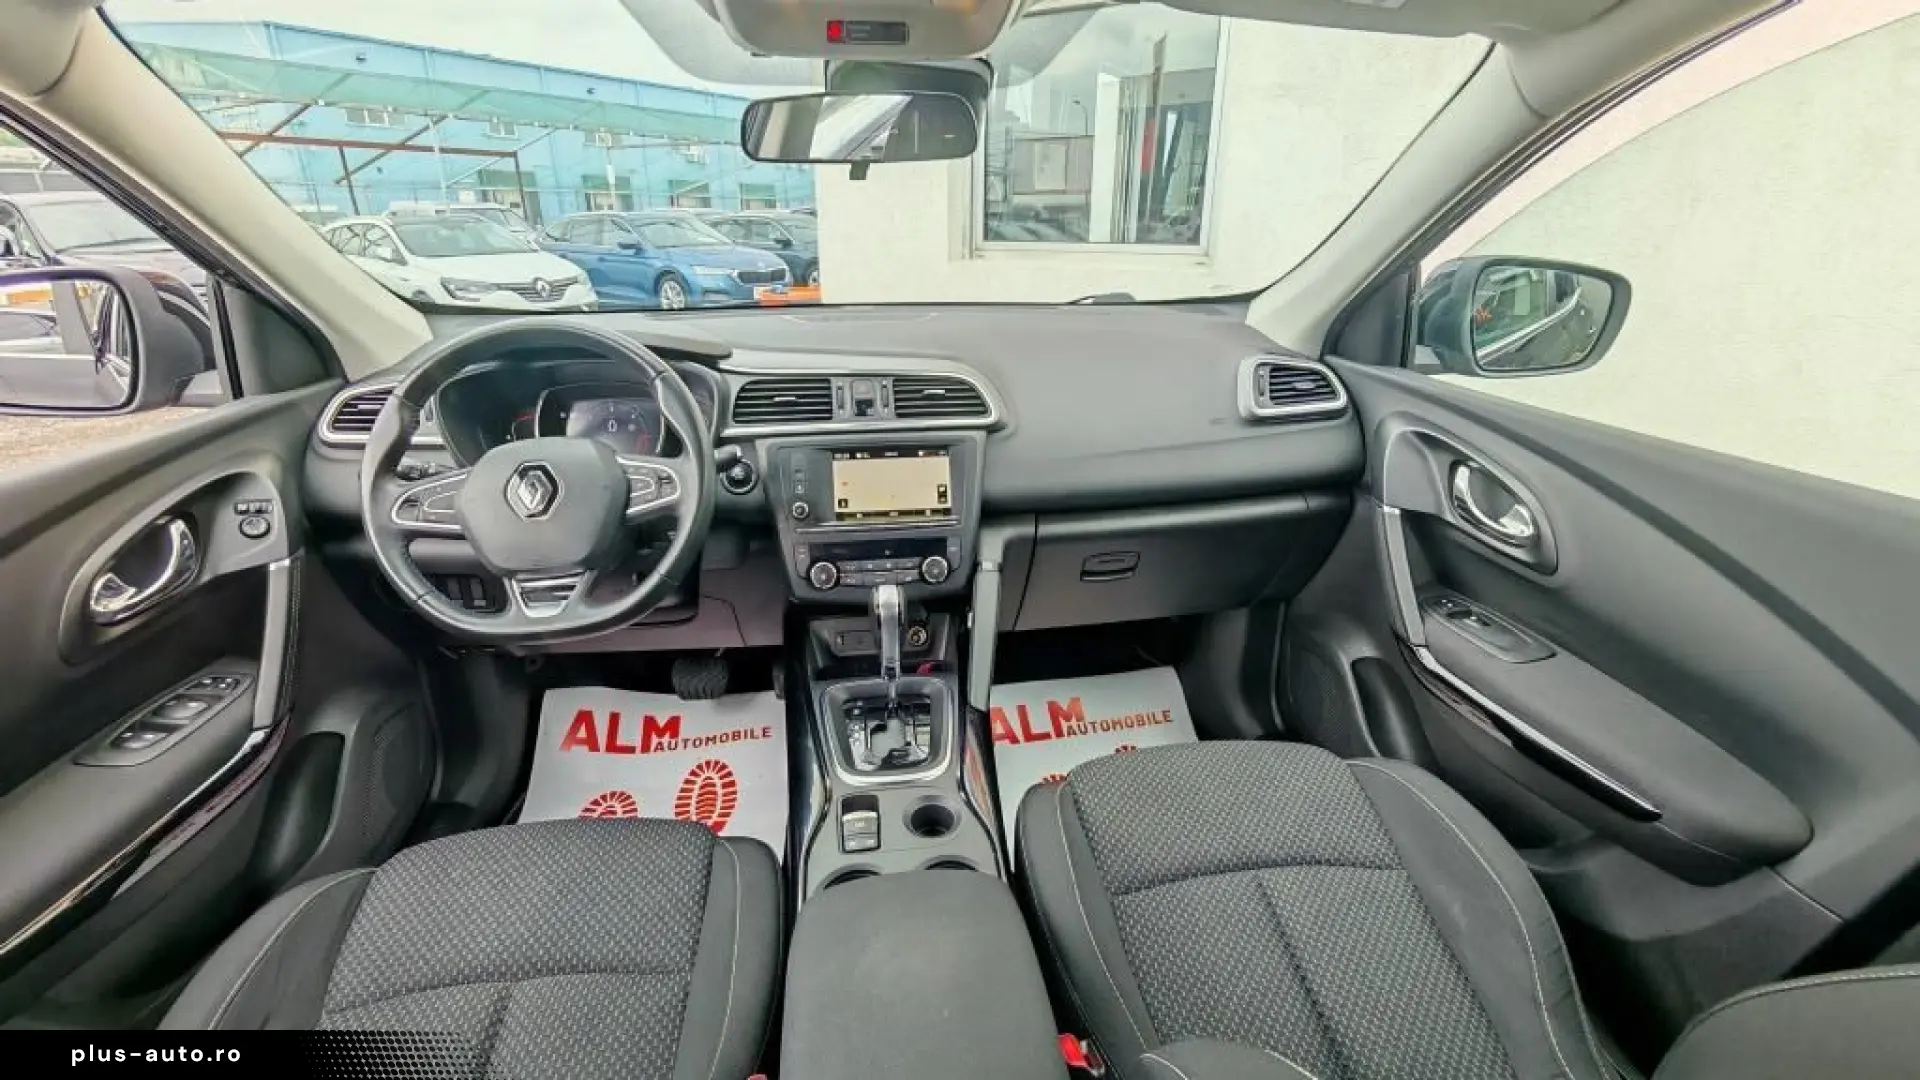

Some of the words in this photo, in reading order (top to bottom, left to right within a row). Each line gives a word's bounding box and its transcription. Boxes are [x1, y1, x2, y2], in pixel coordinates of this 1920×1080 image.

[559, 708, 682, 755] ALM
[653, 726, 773, 753] AUTOMOBILE
[990, 697, 1085, 745] ALM
[1066, 709, 1174, 737] AUTOMOBILE
